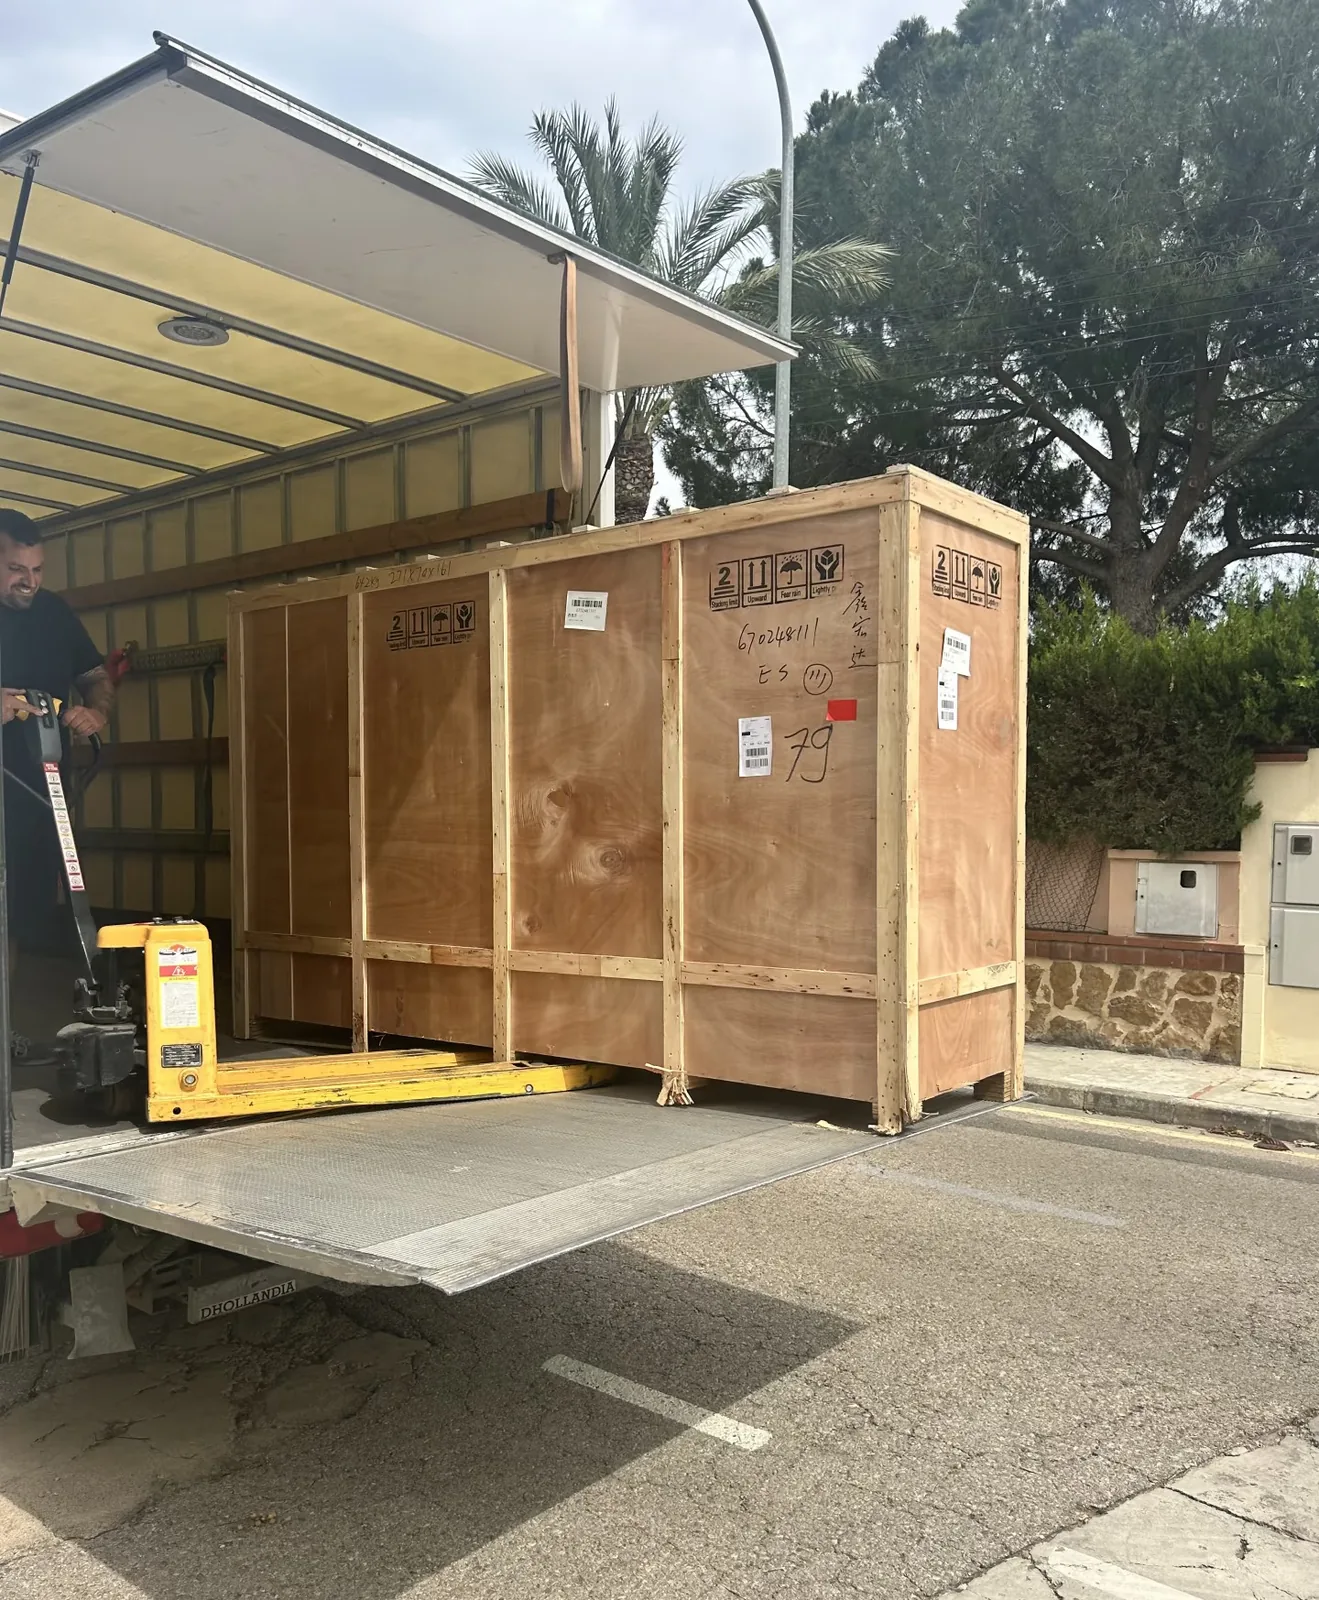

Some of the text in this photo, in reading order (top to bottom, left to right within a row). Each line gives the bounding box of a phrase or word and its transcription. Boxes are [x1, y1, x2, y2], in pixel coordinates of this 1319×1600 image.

[938, 550, 945, 570] 2
[719, 566, 731, 586] 2
[201, 1281, 295, 1319] DHOLLANDIA
